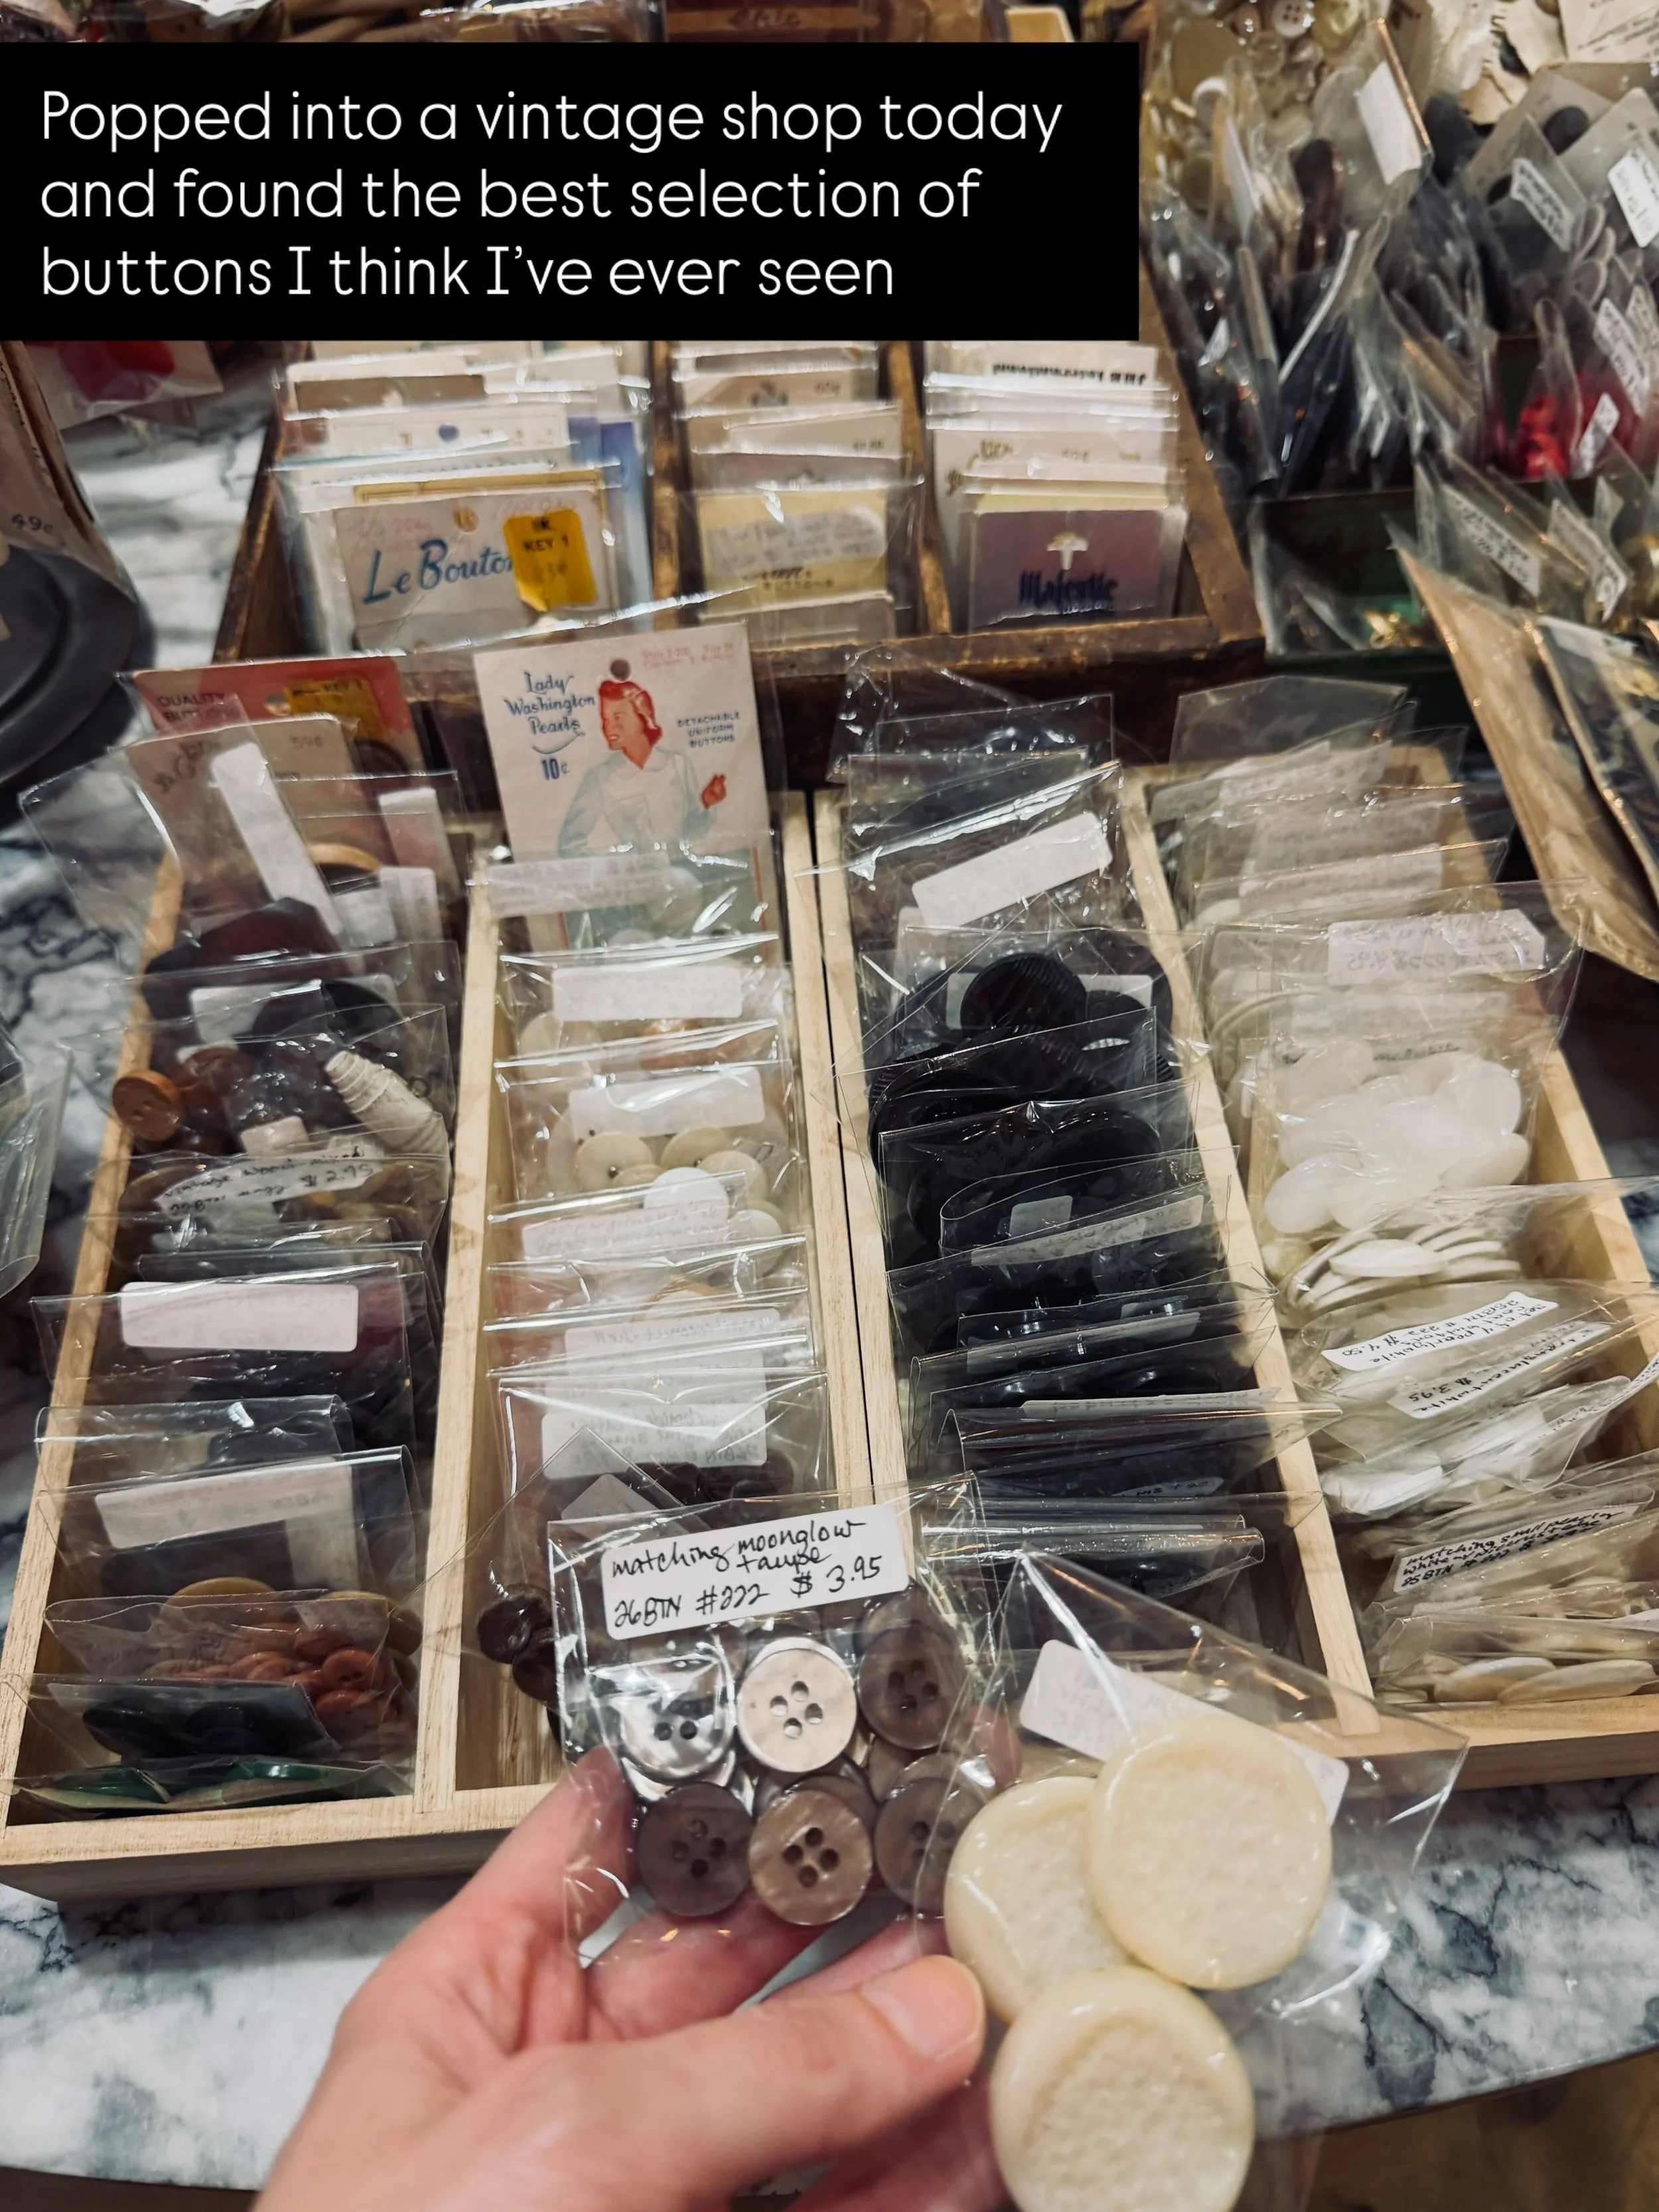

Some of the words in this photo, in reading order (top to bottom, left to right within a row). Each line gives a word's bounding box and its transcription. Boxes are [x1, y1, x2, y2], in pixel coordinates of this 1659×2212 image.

[524, 672, 575, 695] Lady
[159, 692, 226, 708] QUALITY
[504, 695, 596, 716] Washington
[528, 716, 581, 735] Pearls
[676, 712, 740, 728] DETACHABLE
[687, 724, 735, 738] UNIFORM
[689, 735, 735, 749] BUTTONS
[612, 1542, 735, 1579] matching
[738, 1520, 867, 1556] moonglow
[736, 1546, 832, 1574] taupe
[1403, 1557, 1449, 1576] white
[826, 1554, 883, 1593] 3.95
